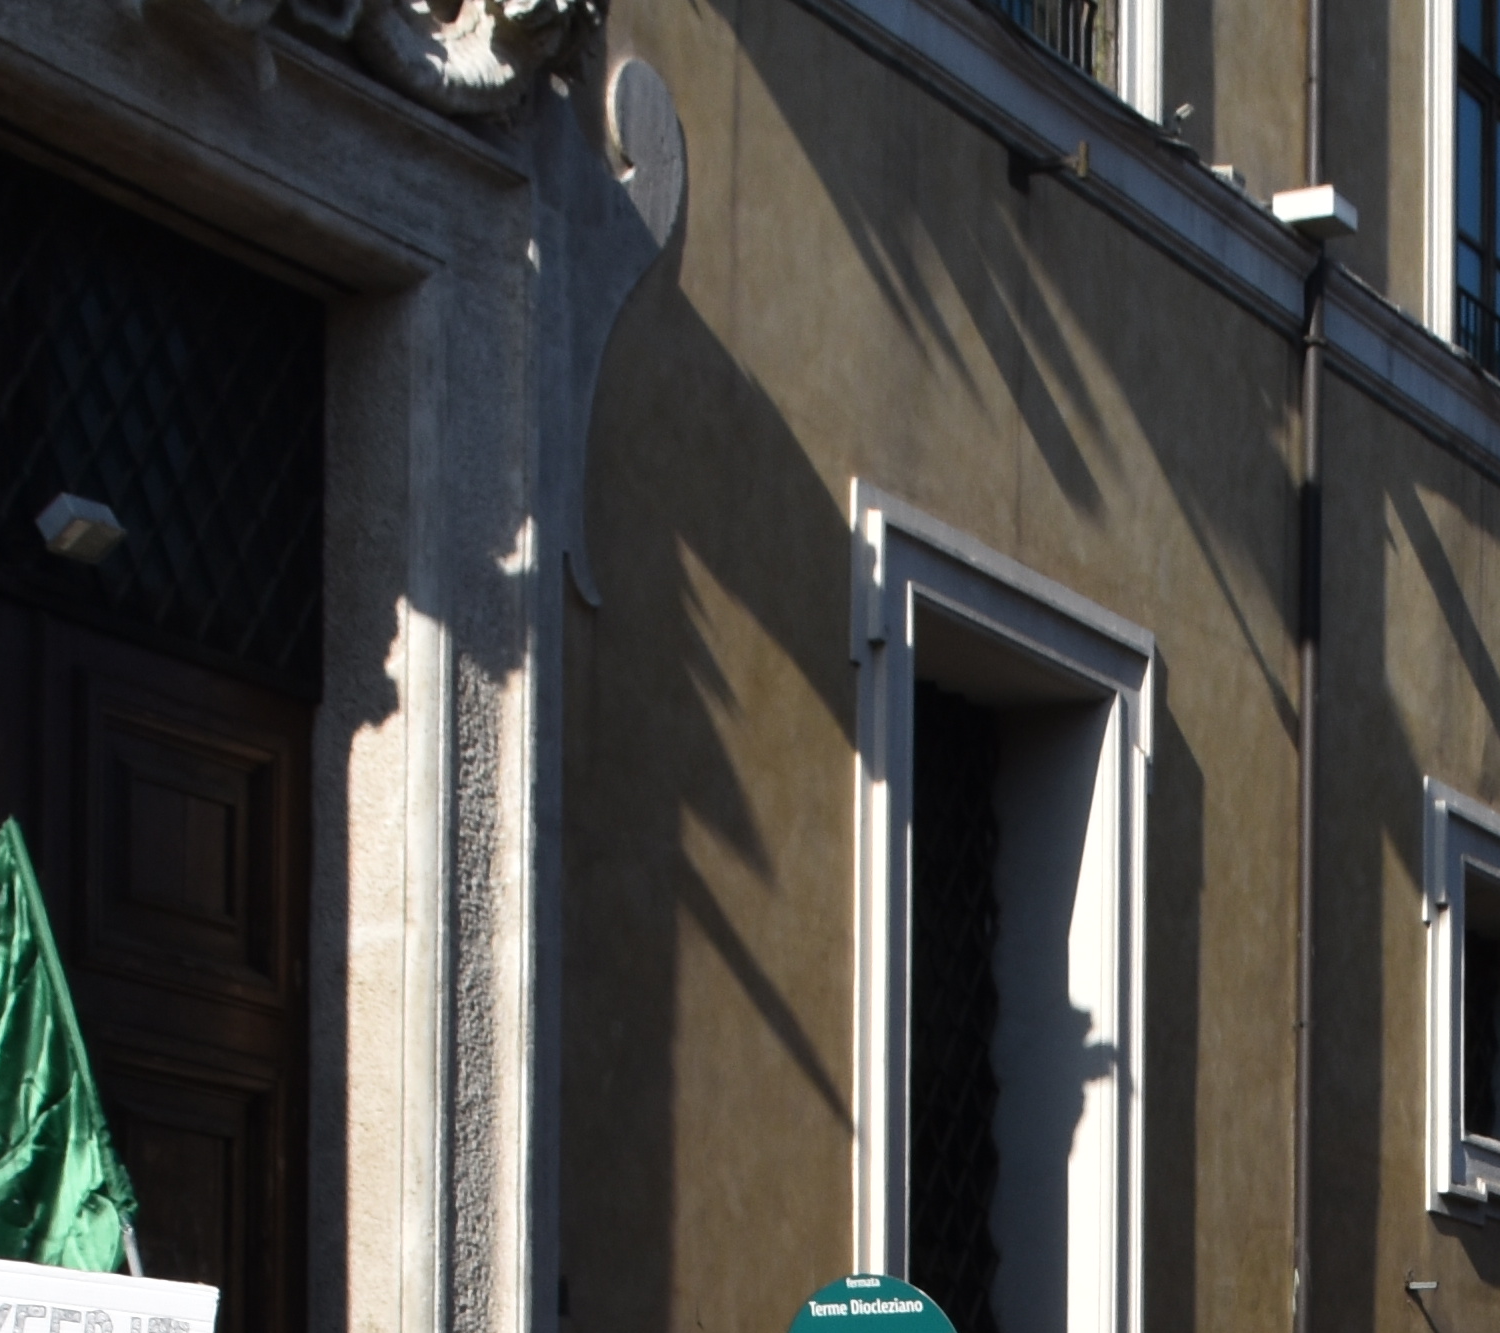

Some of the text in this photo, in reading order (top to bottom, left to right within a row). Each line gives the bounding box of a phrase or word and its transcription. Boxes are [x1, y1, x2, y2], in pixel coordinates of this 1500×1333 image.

[846, 1277, 880, 1288] fermata
[808, 1297, 923, 1317] Terme Diocleziano
